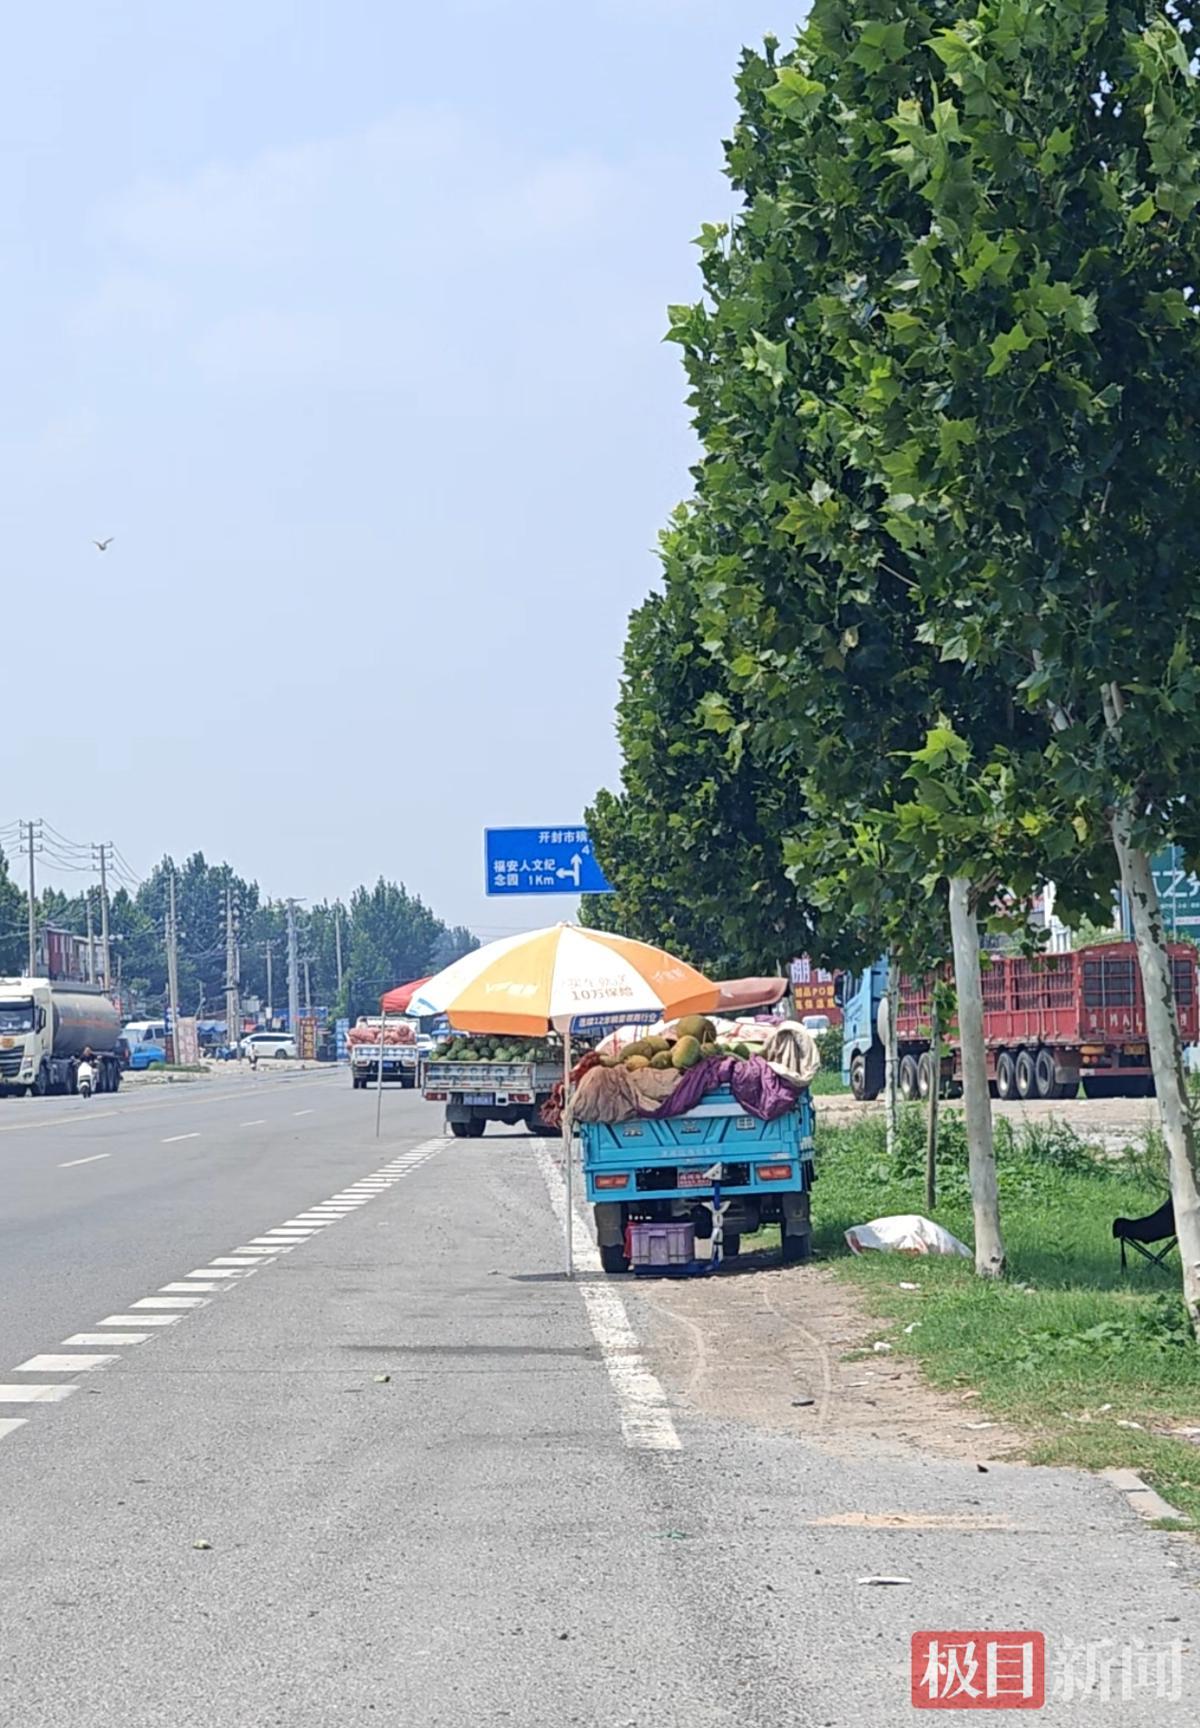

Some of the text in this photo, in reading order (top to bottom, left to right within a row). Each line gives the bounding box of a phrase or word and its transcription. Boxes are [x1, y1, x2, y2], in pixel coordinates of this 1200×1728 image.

[538, 830, 593, 844] 开封市殡
[494, 858, 556, 873] 福安人文纪
[494, 874, 519, 886] 念园
